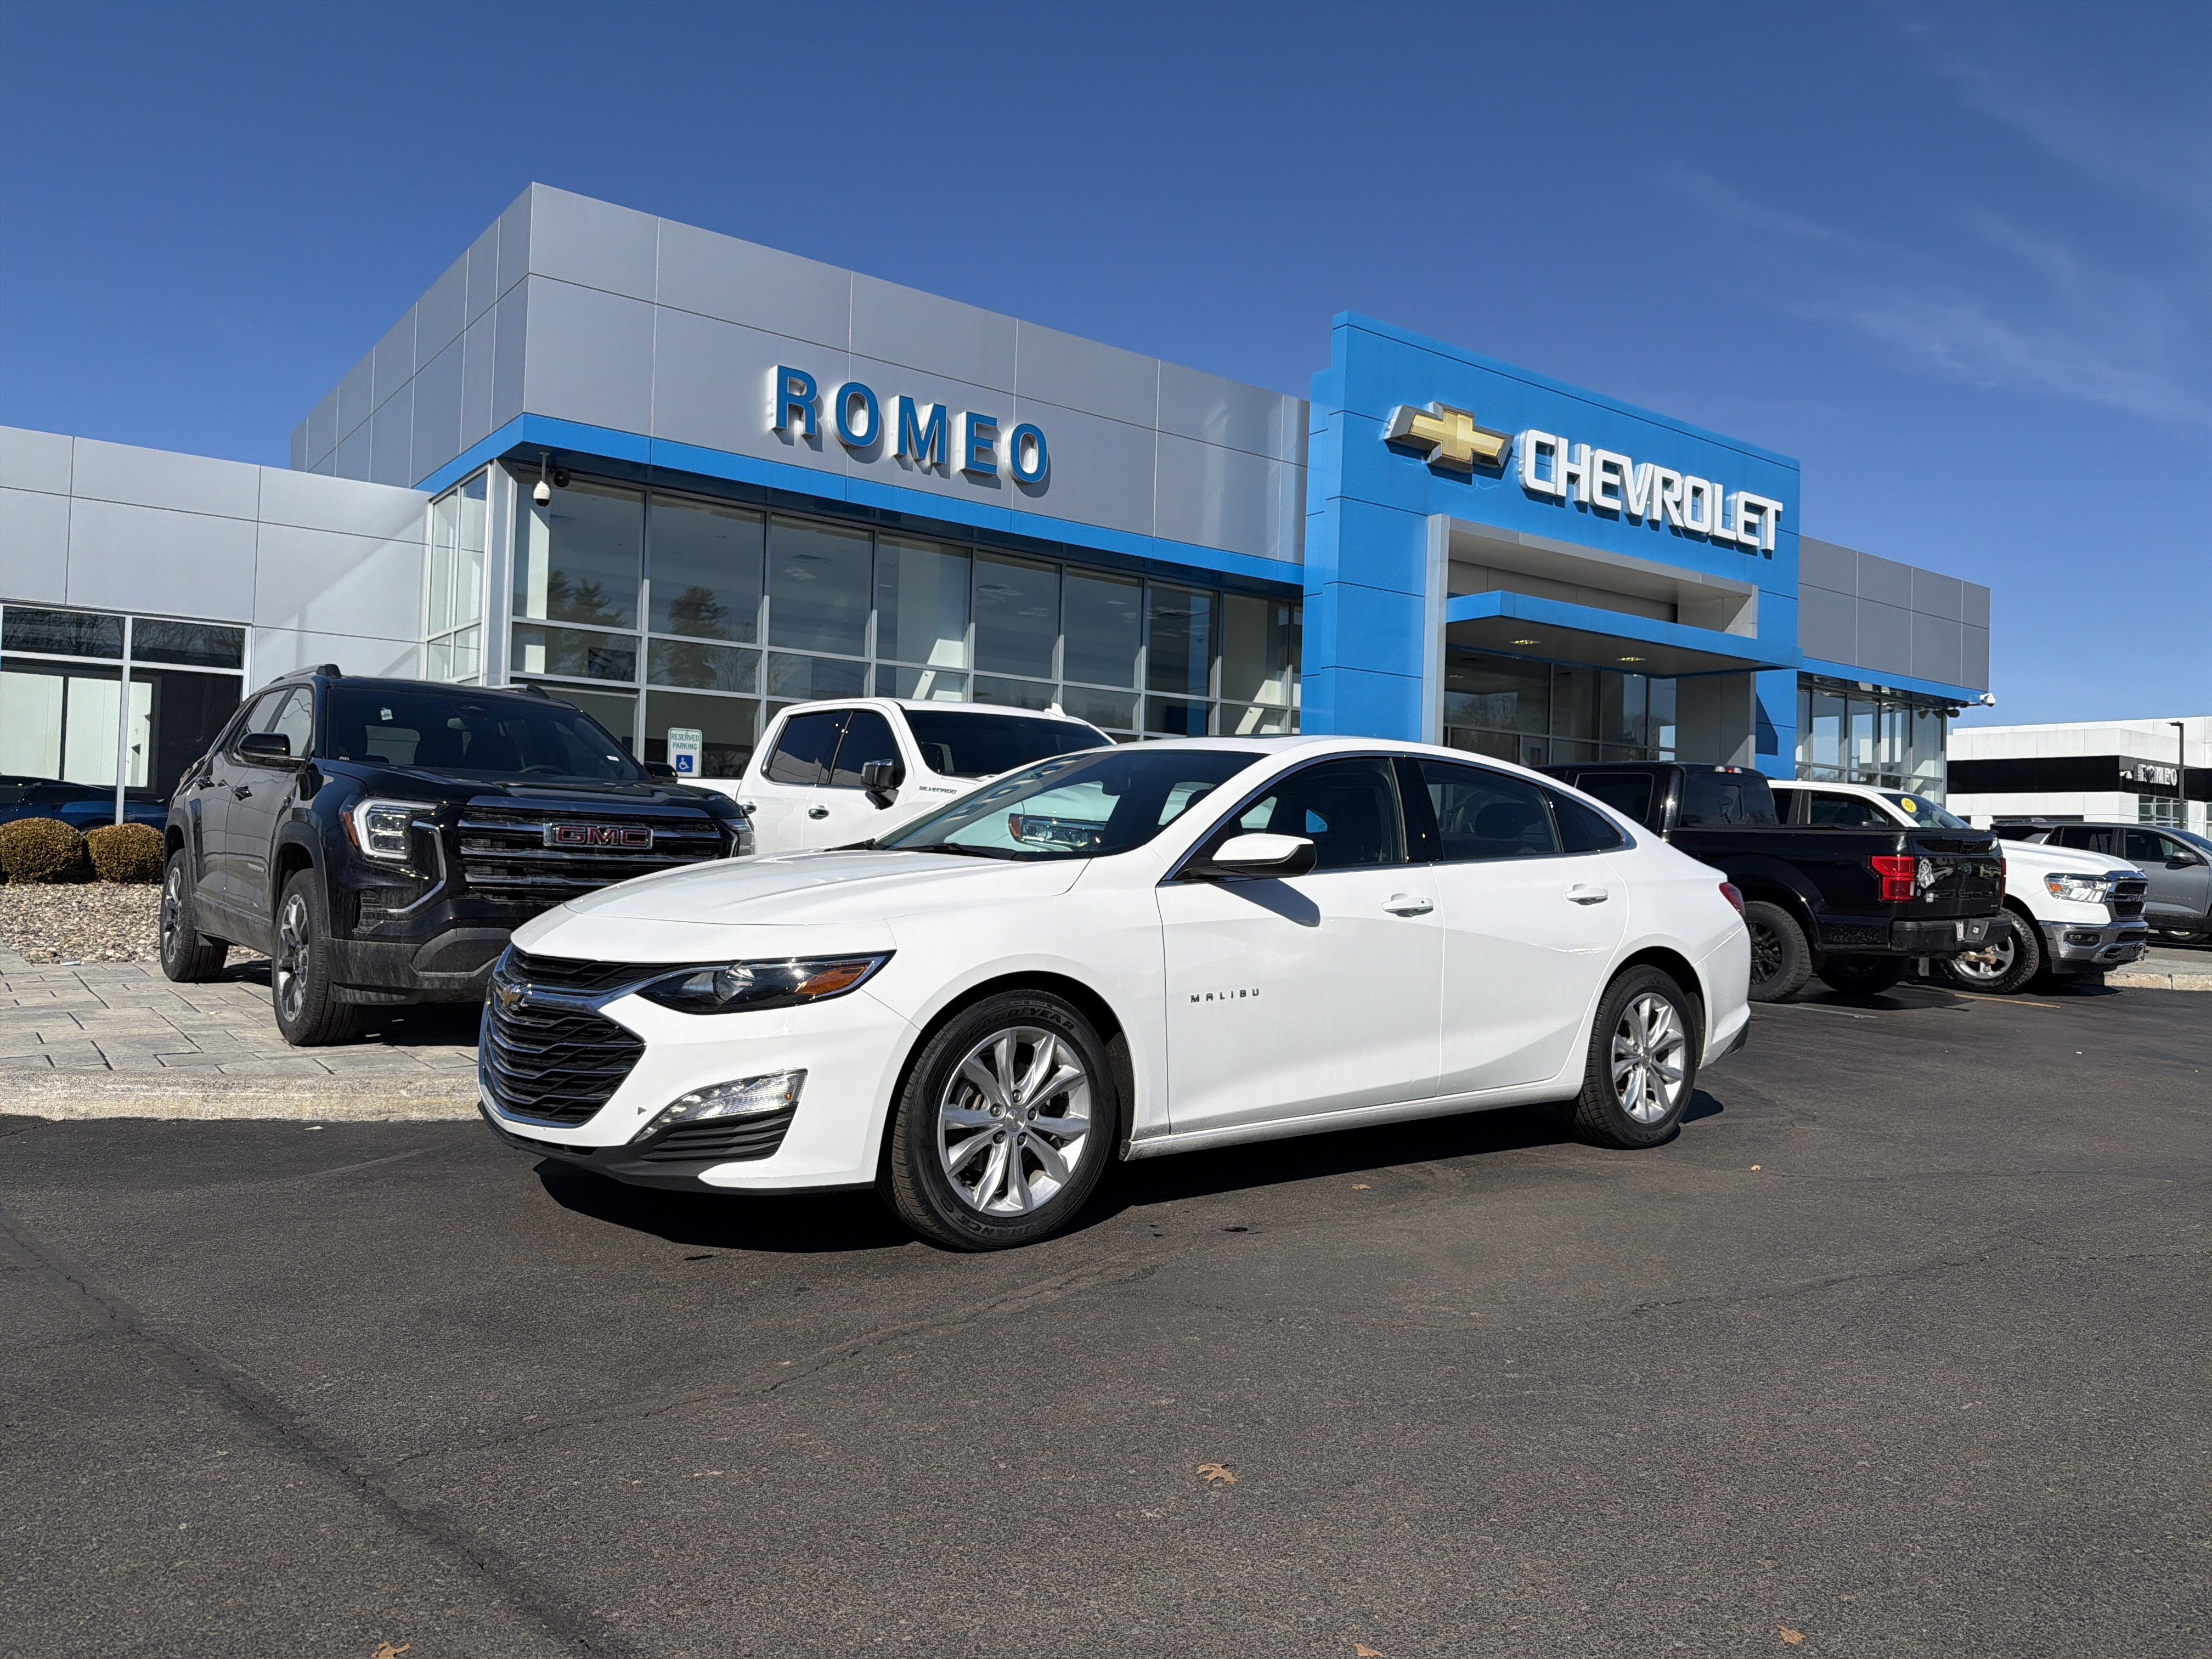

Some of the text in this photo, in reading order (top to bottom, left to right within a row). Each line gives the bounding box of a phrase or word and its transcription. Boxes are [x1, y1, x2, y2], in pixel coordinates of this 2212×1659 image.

[771, 365, 1047, 483] ROMEO
[1520, 429, 1783, 550] CHEVROLET
[671, 733, 699, 741] RESERVED
[2137, 764, 2177, 786] ROMEO
[556, 826, 647, 846] GMC
[1190, 988, 1260, 1003] MALIBU
